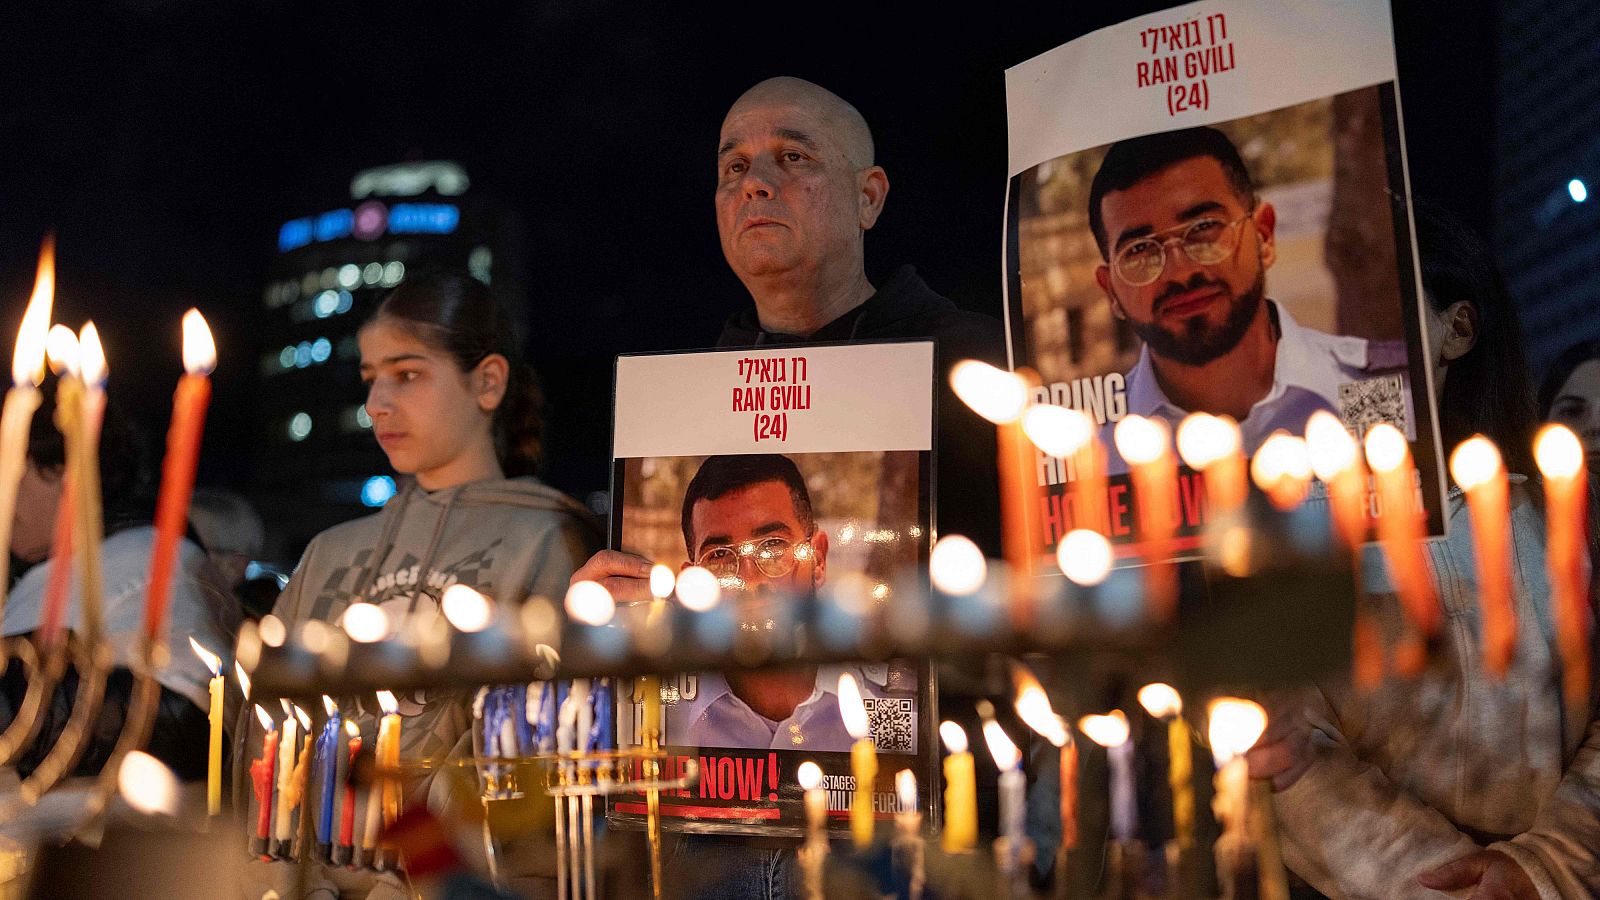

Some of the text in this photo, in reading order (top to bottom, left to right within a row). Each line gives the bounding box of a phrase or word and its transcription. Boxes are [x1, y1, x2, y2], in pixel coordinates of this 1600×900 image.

[1140, 13, 1228, 55] רן גואילי
[1136, 43, 1236, 88] RAN GVILI
[1167, 79, 1210, 116] (24)
[737, 356, 807, 385] רן גואילי
[732, 384, 811, 412] RAN GVILI
[753, 412, 788, 442] (24)
[699, 752, 780, 803] NOW!
[814, 775, 856, 791] STAGES
